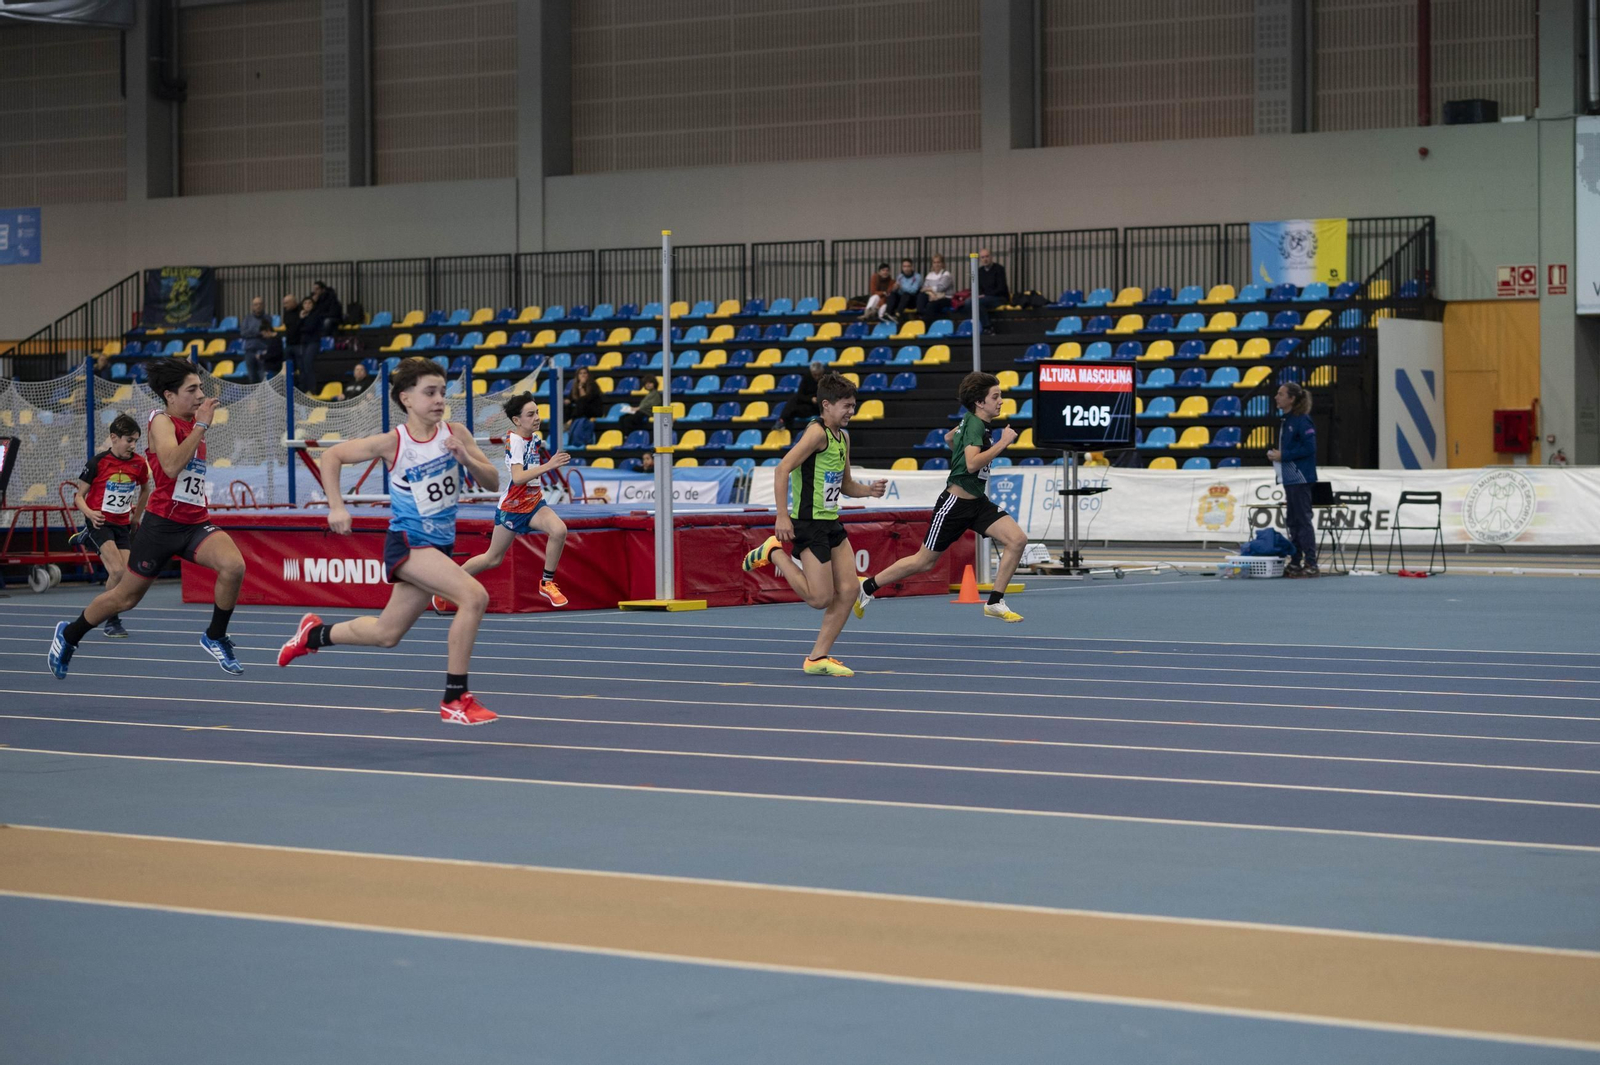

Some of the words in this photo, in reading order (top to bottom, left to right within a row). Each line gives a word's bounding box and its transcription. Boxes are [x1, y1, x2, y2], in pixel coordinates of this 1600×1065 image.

[1040, 367, 1077, 383] ALTURA
[1079, 368, 1133, 384] MASCULINA
[1062, 404, 1111, 427] 12:05
[426, 475, 456, 502] 88
[1478, 472, 1517, 489] MUNICIPAL
[684, 486, 699, 500] de
[1252, 508, 1390, 531] OUENSE
[303, 558, 388, 584] MOND
